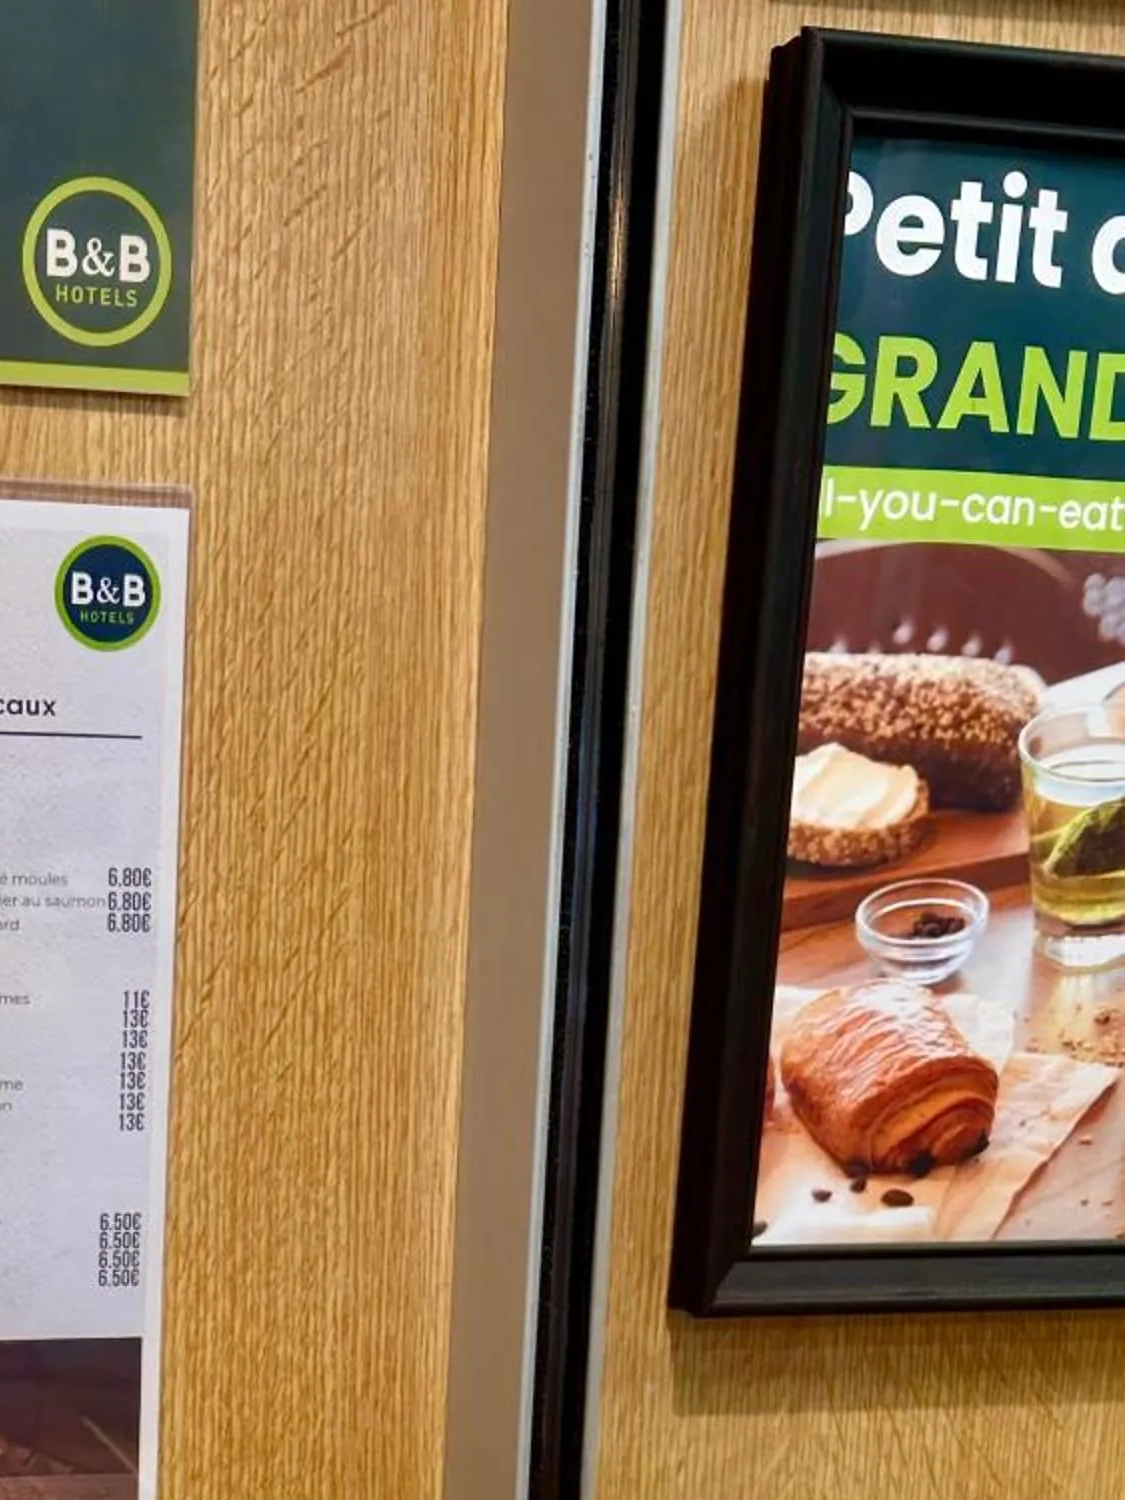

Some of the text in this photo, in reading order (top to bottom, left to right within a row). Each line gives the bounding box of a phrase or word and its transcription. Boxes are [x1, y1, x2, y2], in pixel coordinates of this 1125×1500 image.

[46, 228, 150, 283] B&B
[55, 284, 137, 307] HOTELS
[71, 571, 146, 607] B&B
[80, 610, 135, 624] HOTELS
[12, 872, 68, 886] moules
[108, 868, 152, 887] 6.80€
[23, 896, 41, 908] au
[46, 896, 106, 908] saumon
[108, 892, 151, 911] 6.80€
[107, 914, 150, 933] 6.80€
[123, 991, 150, 1009] 11€
[123, 1010, 149, 1028] 13€
[123, 1030, 148, 1048] 13€
[120, 1052, 146, 1070] 13€
[120, 1072, 146, 1090] 13€
[119, 1093, 146, 1111] 13€
[119, 1113, 145, 1131] 13€
[100, 1213, 142, 1230] 6.50€
[100, 1232, 140, 1249] 6.50€
[99, 1251, 140, 1268] 6.50€
[98, 1270, 139, 1287] 6.50€
